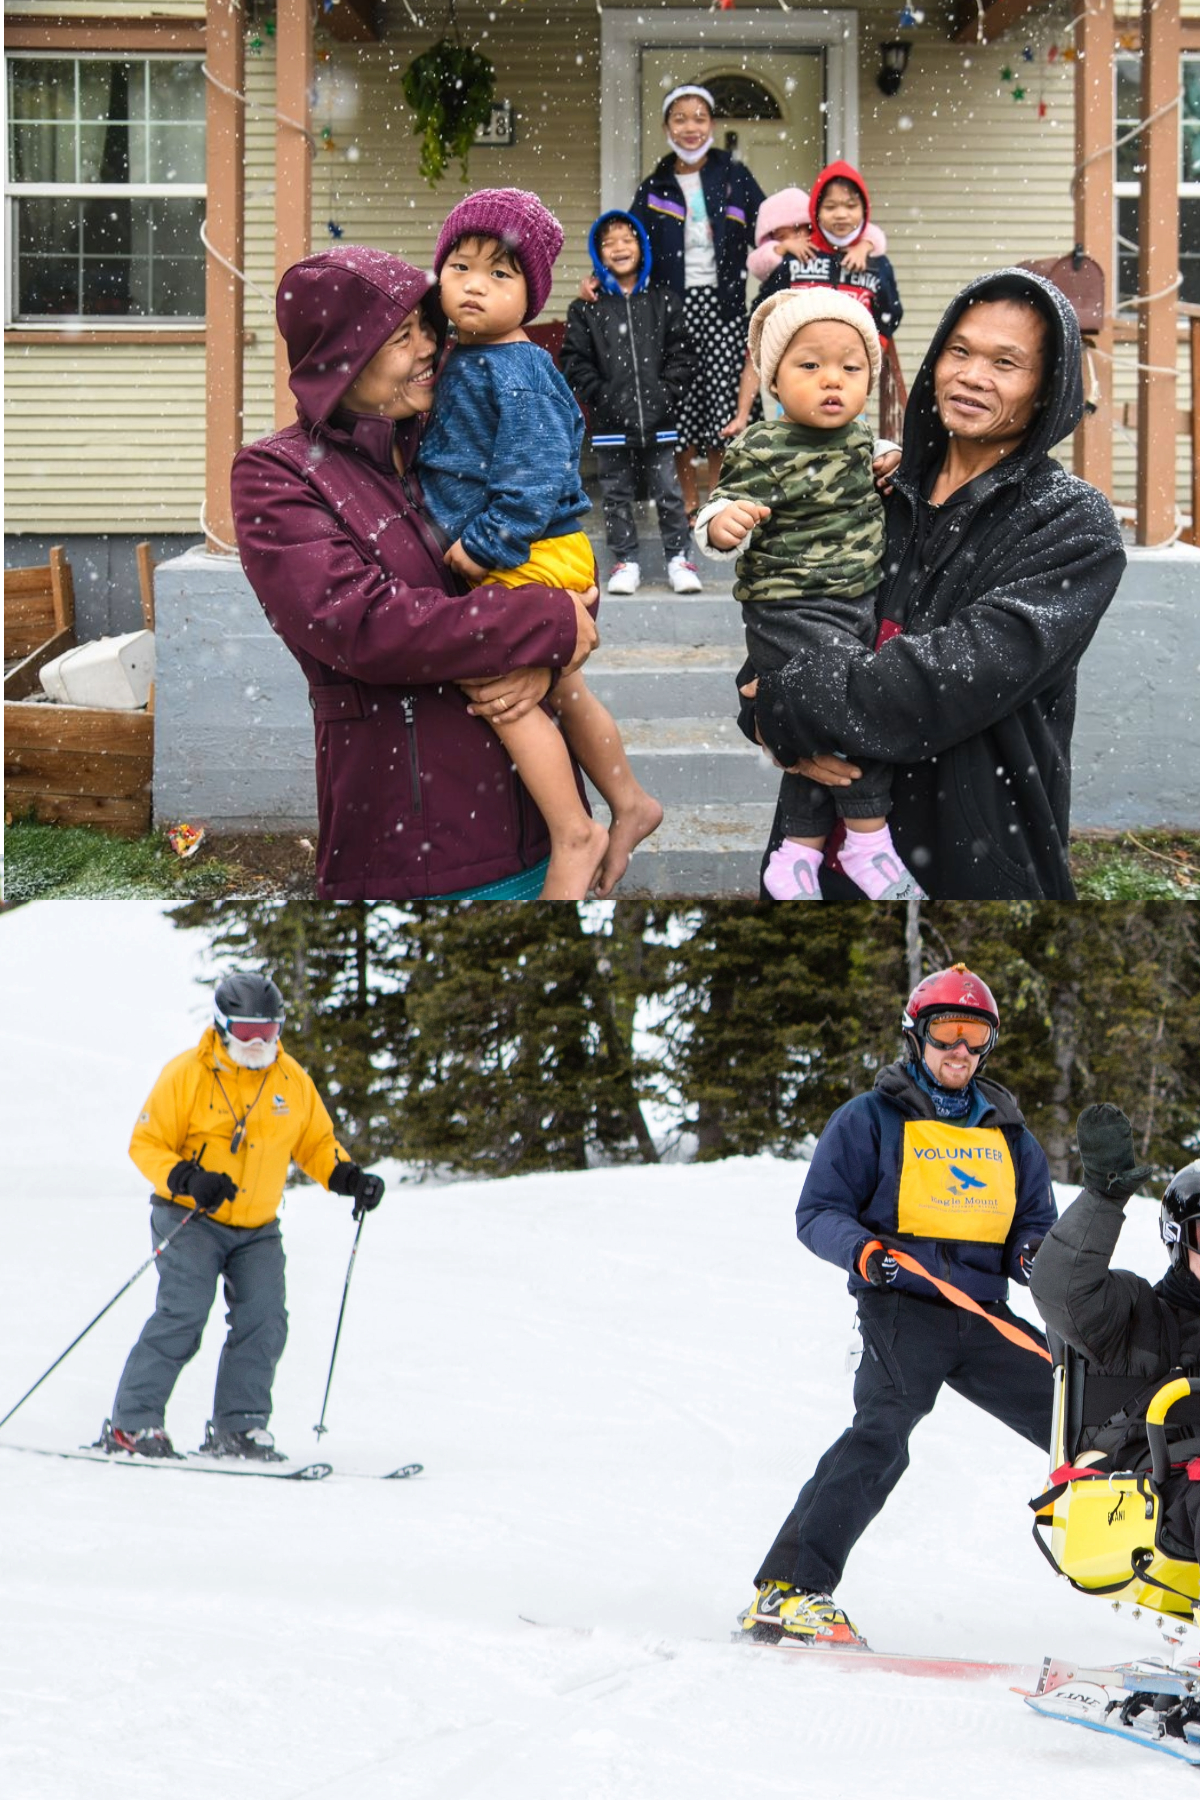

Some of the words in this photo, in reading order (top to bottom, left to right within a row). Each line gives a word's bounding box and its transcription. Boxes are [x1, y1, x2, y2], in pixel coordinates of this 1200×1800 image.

[913, 1147, 1004, 1163] VOLUNTEER
[931, 1195, 961, 1207] Eagle
[965, 1196, 998, 1206] Mount
